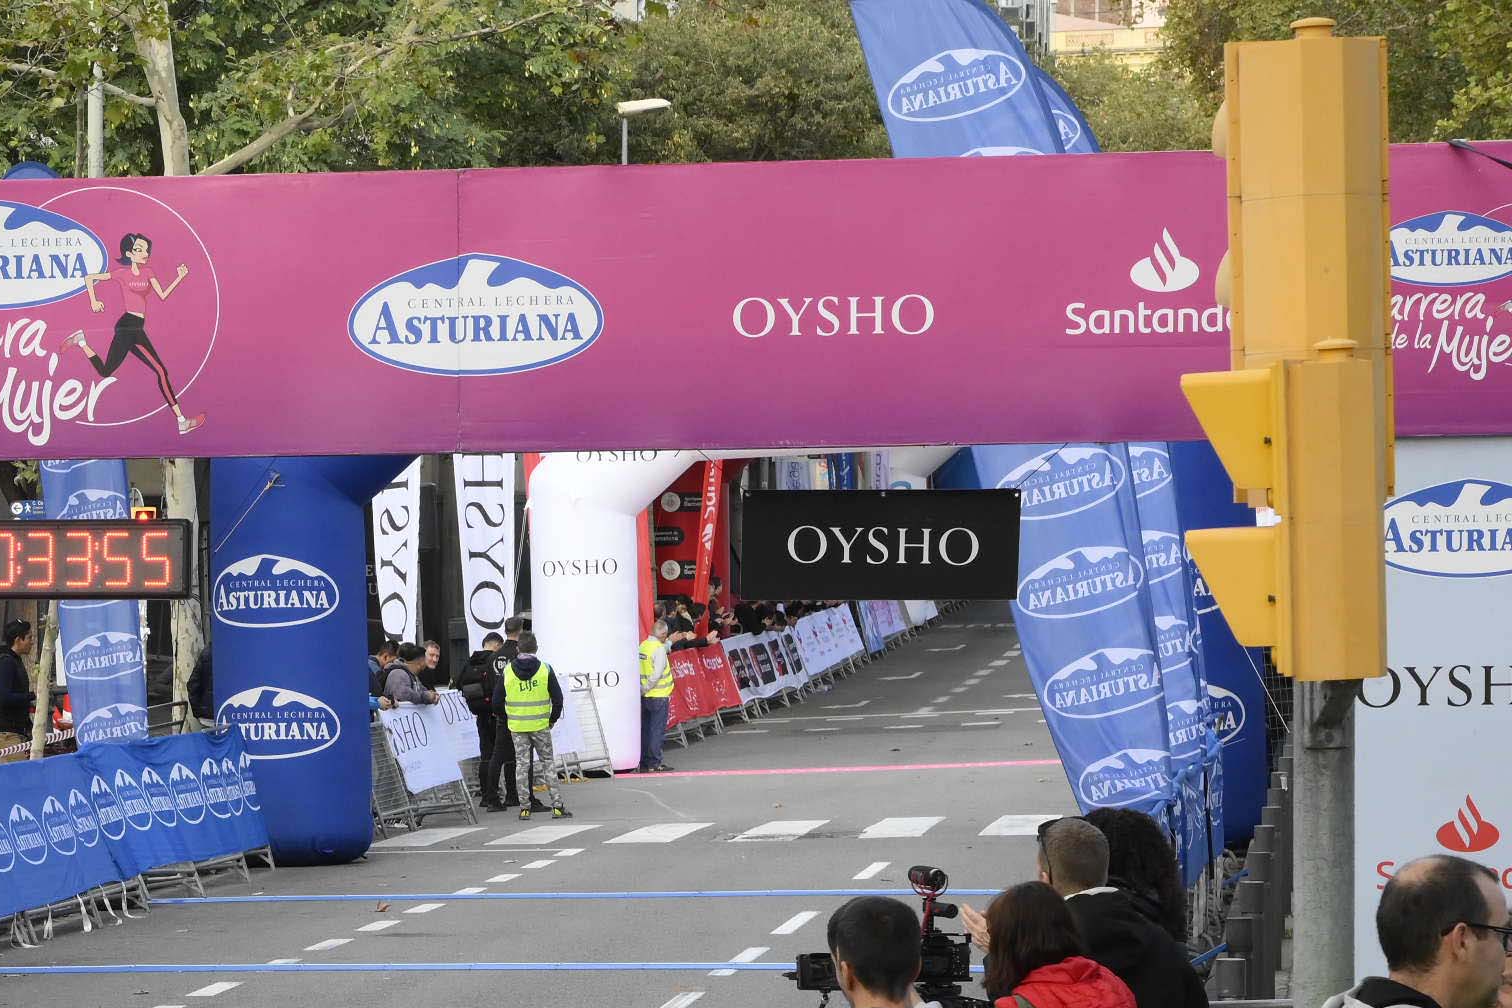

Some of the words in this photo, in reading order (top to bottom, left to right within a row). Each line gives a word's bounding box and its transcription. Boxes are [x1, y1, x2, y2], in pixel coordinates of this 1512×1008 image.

[11, 237, 83, 248] LECHERA
[1405, 237, 1455, 246] CENTRAL
[1461, 236, 1512, 245] LECHERA
[407, 296, 485, 310] CENTRAL
[494, 294, 576, 307] LECHERA
[1391, 291, 1487, 322] arrera
[367, 301, 584, 345] ASTURIANA
[732, 293, 935, 338] OYSHO
[1414, 322, 1432, 350] la
[1427, 315, 1512, 381] Muje
[1411, 513, 1480, 524] CENTRAL
[1486, 512, 1512, 523] LEC
[787, 524, 981, 567] OYSHO
[542, 557, 618, 577] OYSHO
[229, 580, 272, 589] CENTRAL
[276, 579, 326, 588] LECHERA
[217, 583, 331, 612] ASTURIANA
[519, 678, 539, 694] Life
[573, 670, 620, 689] SHO
[1356, 664, 1512, 709] OYSH
[231, 711, 273, 719] CENTRAL
[276, 711, 327, 719] LECHERA
[439, 689, 474, 726] OYS
[228, 717, 331, 741] TURIANA
[389, 711, 428, 757] SHO
